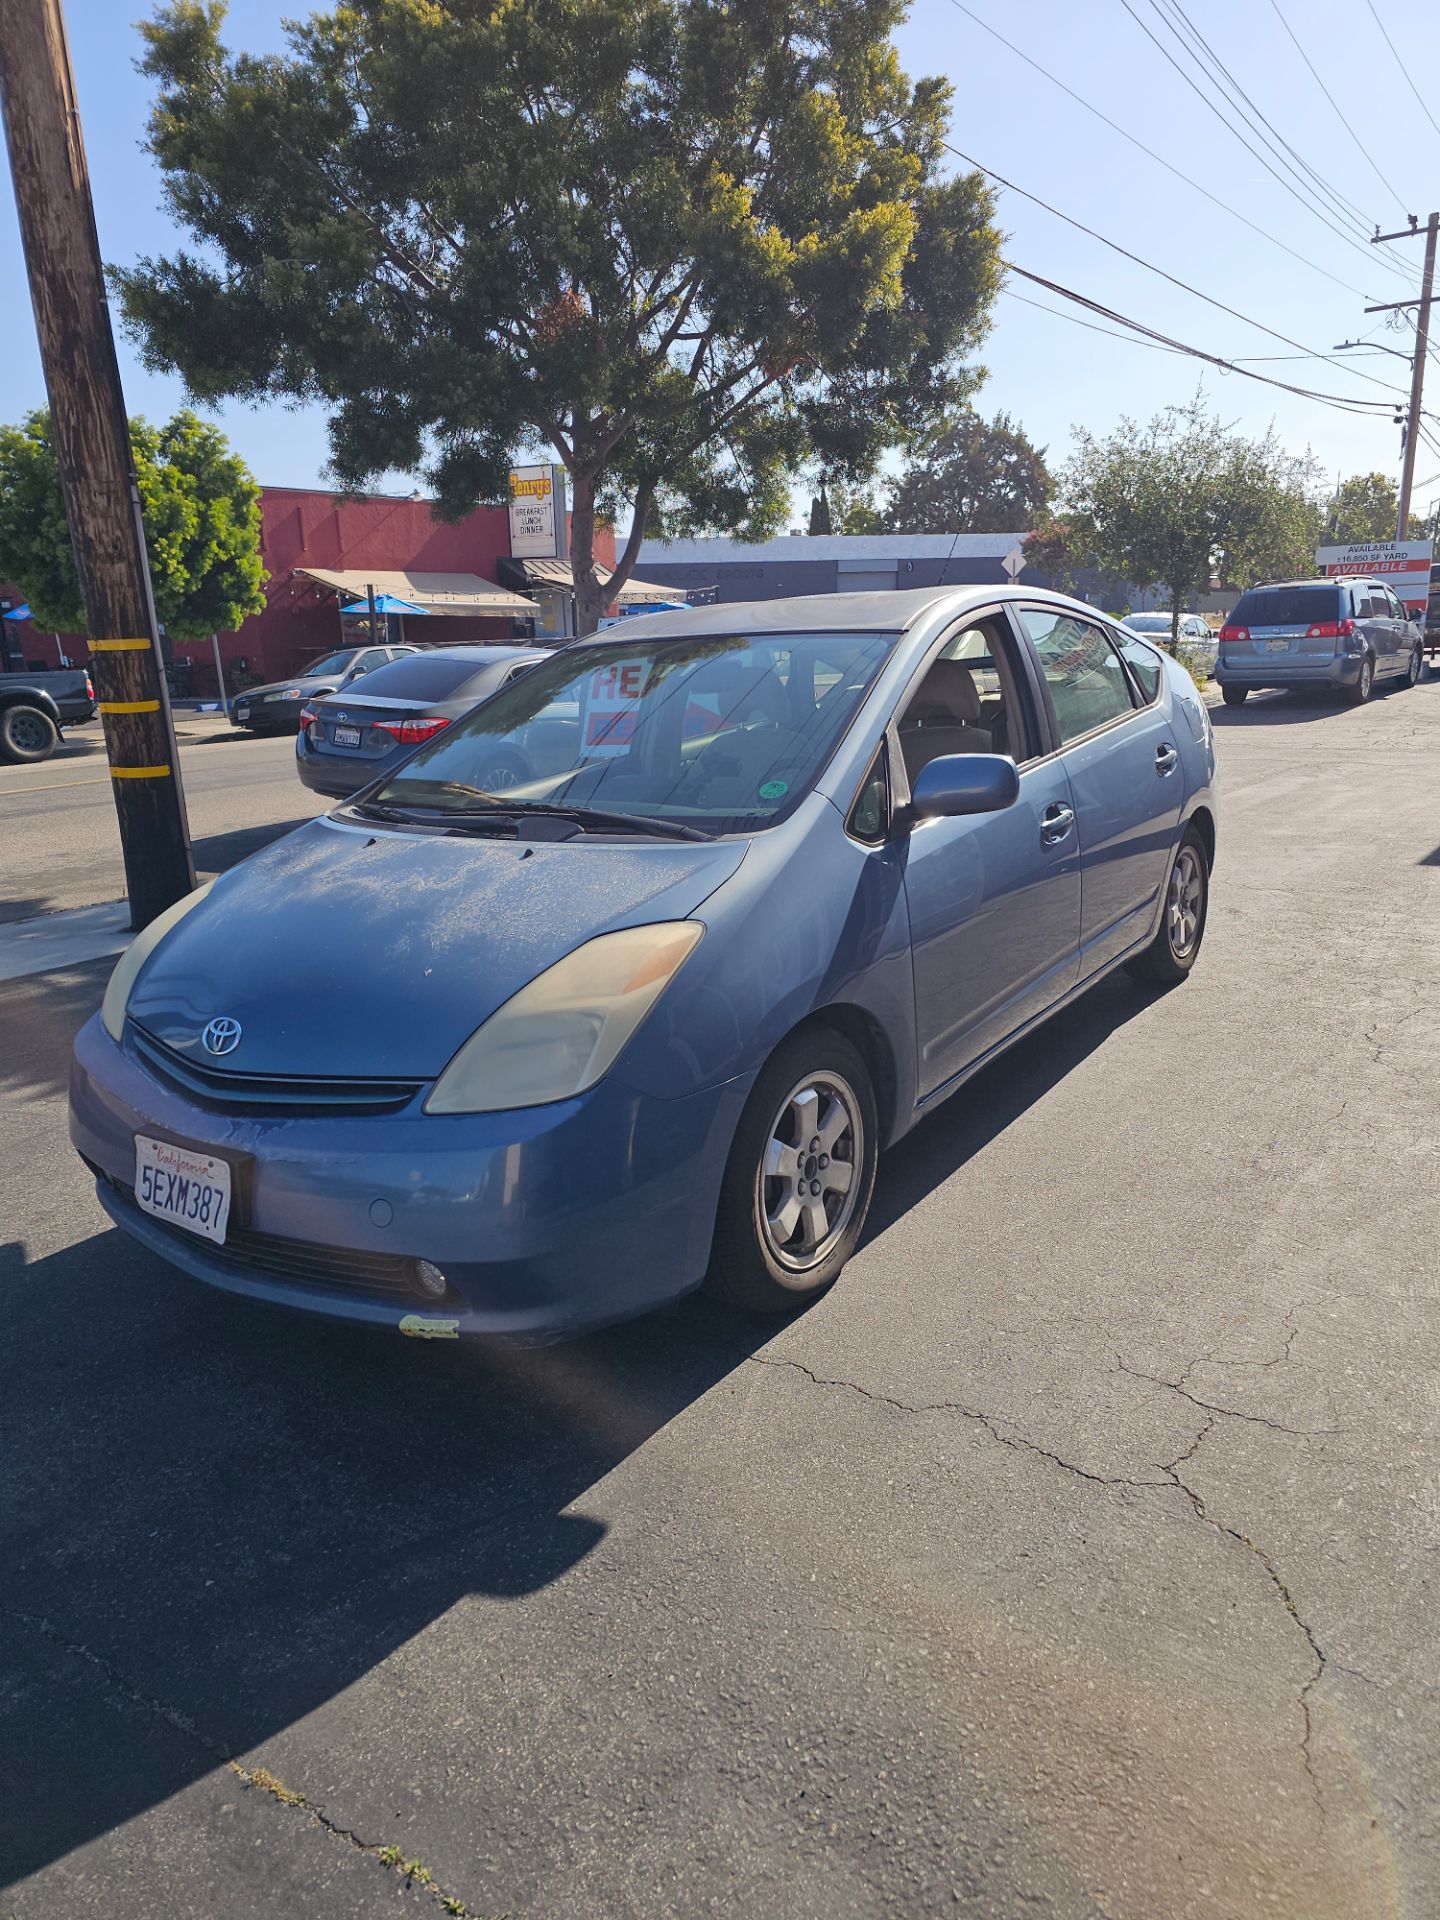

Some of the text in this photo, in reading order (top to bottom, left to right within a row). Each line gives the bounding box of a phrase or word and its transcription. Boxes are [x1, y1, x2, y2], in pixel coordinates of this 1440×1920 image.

[515, 506, 547, 517] BREAKFAST
[521, 516, 542, 526] LUNCH
[520, 525, 543, 535] DINNER
[1348, 543, 1397, 553] AVAILABLE
[1370, 553, 1381, 561] SF
[1381, 552, 1408, 561] YARD
[1332, 561, 1408, 574] AVAILABLE
[156, 1146, 215, 1179] California
[141, 1164, 224, 1229] 5EXM387
